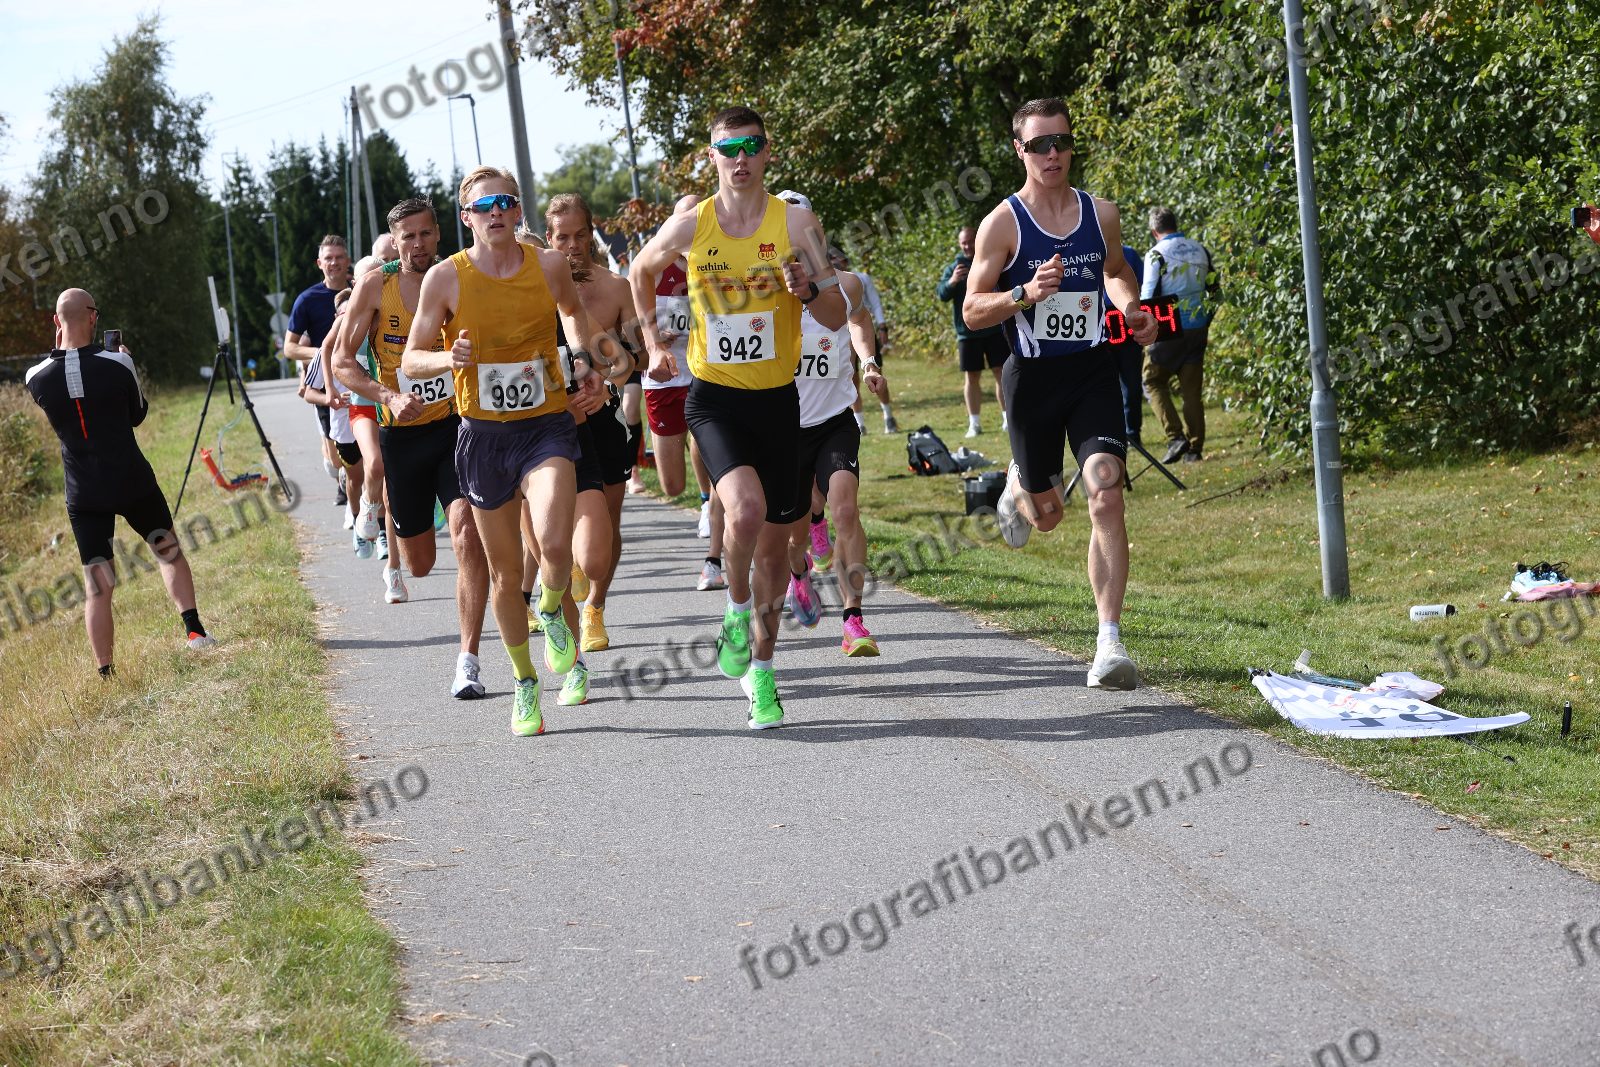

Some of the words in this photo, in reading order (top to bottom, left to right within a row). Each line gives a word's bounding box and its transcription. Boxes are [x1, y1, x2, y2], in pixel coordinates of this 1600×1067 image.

[697, 262, 732, 272] rethink.
[1028, 252, 1102, 269] SPABANKEN
[1063, 268, 1079, 277] ØR
[1046, 314, 1087, 339] 993
[719, 335, 763, 362] 942
[491, 383, 534, 409] 992
